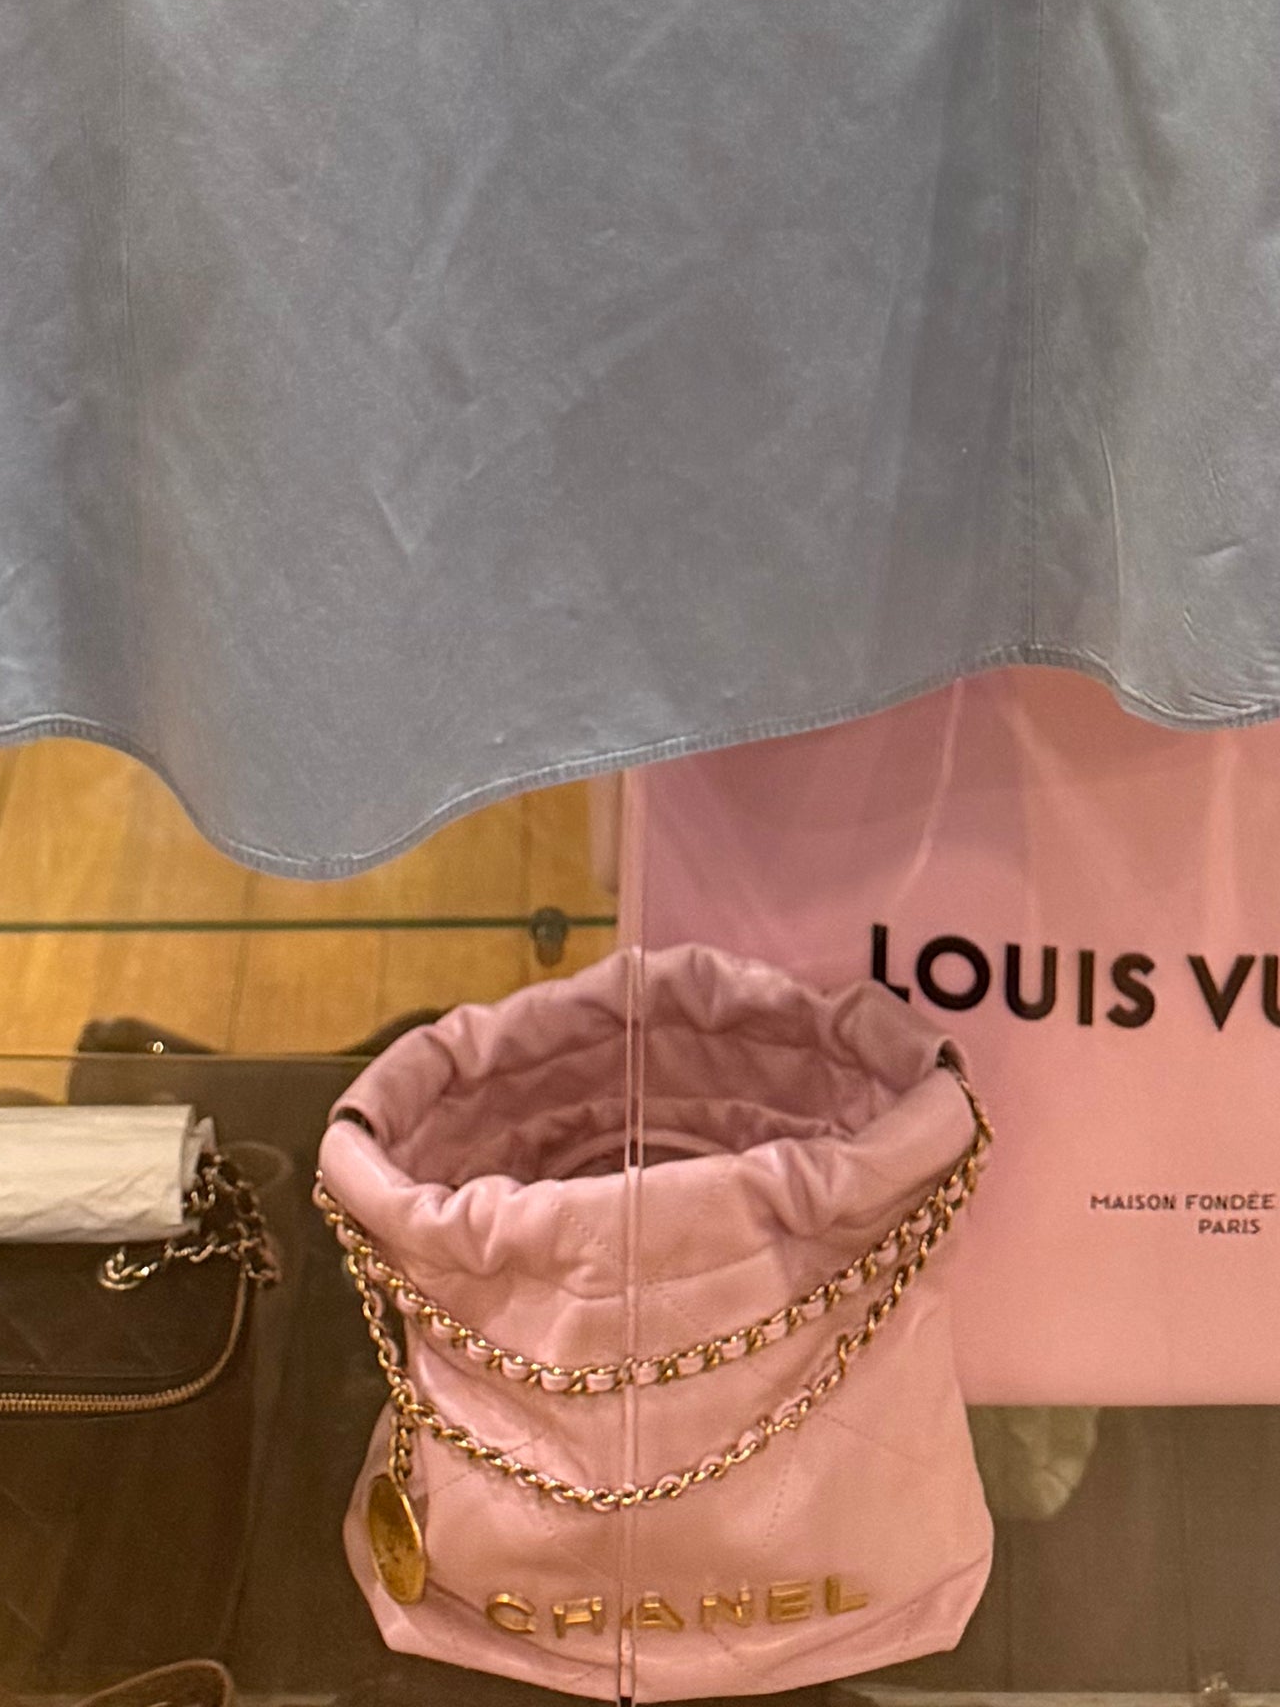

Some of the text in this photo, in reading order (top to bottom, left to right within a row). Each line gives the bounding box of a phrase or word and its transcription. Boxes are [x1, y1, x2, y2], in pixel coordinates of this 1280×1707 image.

[872, 923, 1156, 1029] LOUIS
[1090, 1194, 1177, 1211] MAISON
[1198, 1219, 1261, 1235] PARIS
[487, 1575, 868, 1639] CHANEL
